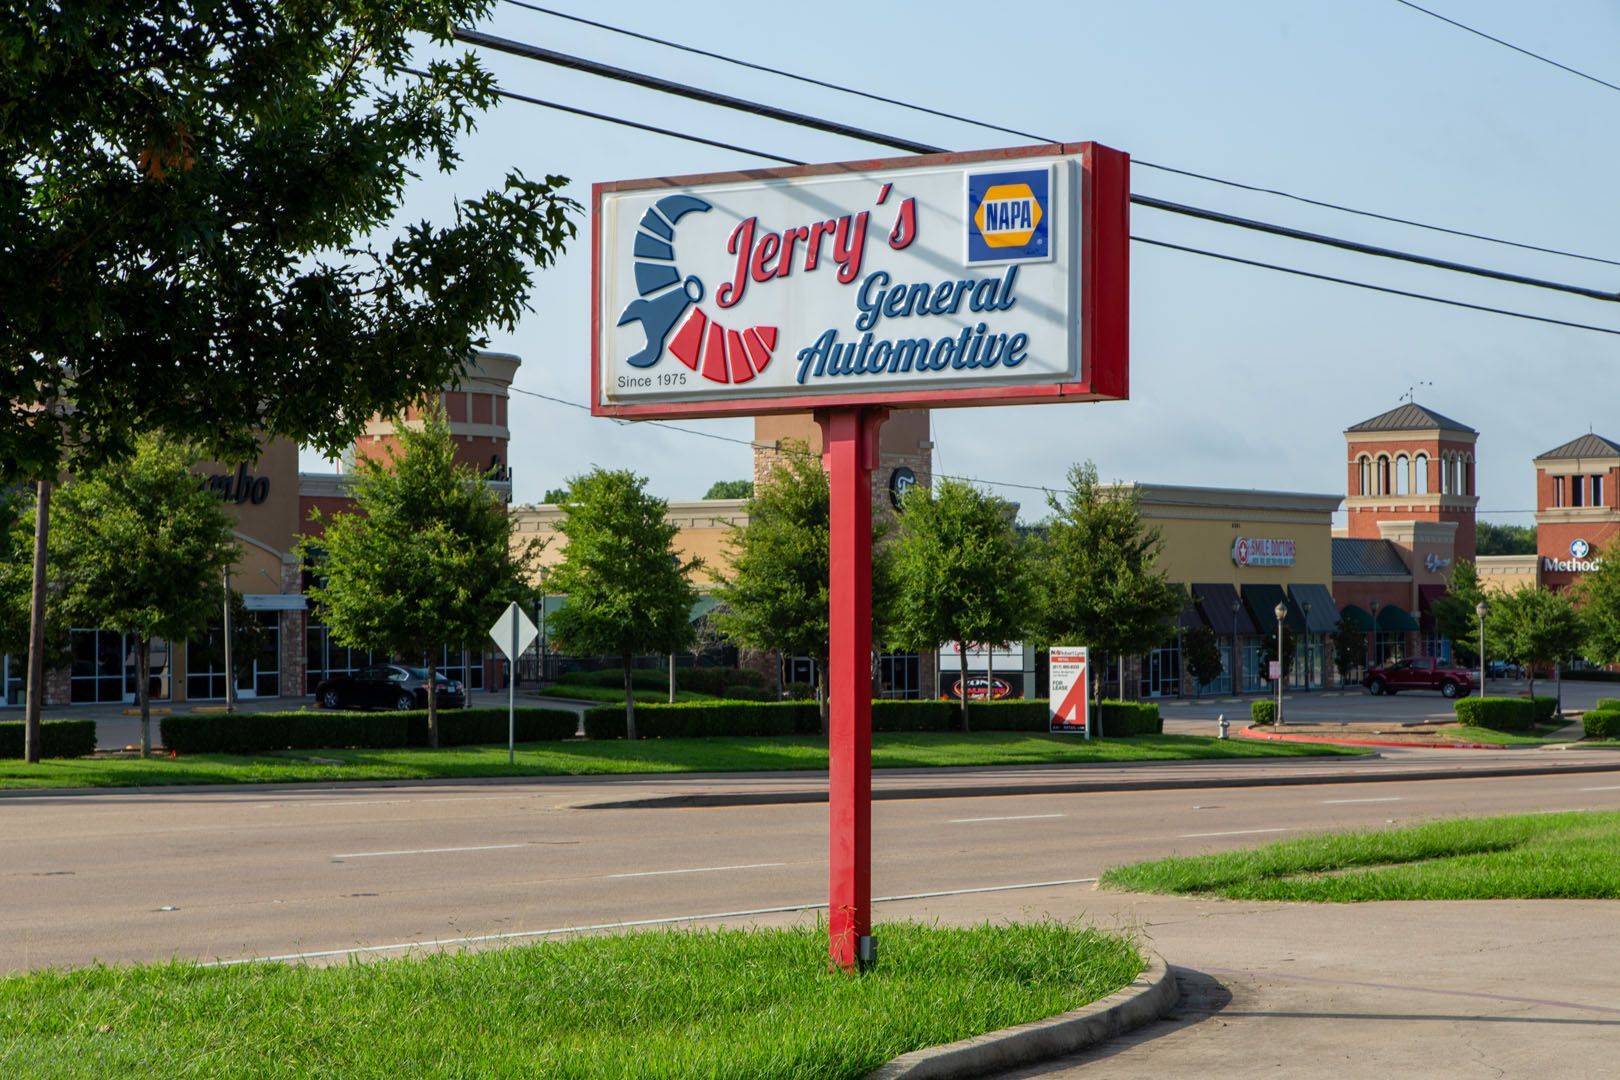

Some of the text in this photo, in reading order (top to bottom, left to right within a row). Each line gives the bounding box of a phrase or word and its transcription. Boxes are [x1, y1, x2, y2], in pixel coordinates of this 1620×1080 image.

[715, 183, 916, 308] Jerry's
[986, 200, 1032, 232] NAPA
[855, 264, 1018, 331] General
[617, 372, 687, 388] Since 1975
[796, 322, 1028, 384] Automotive
